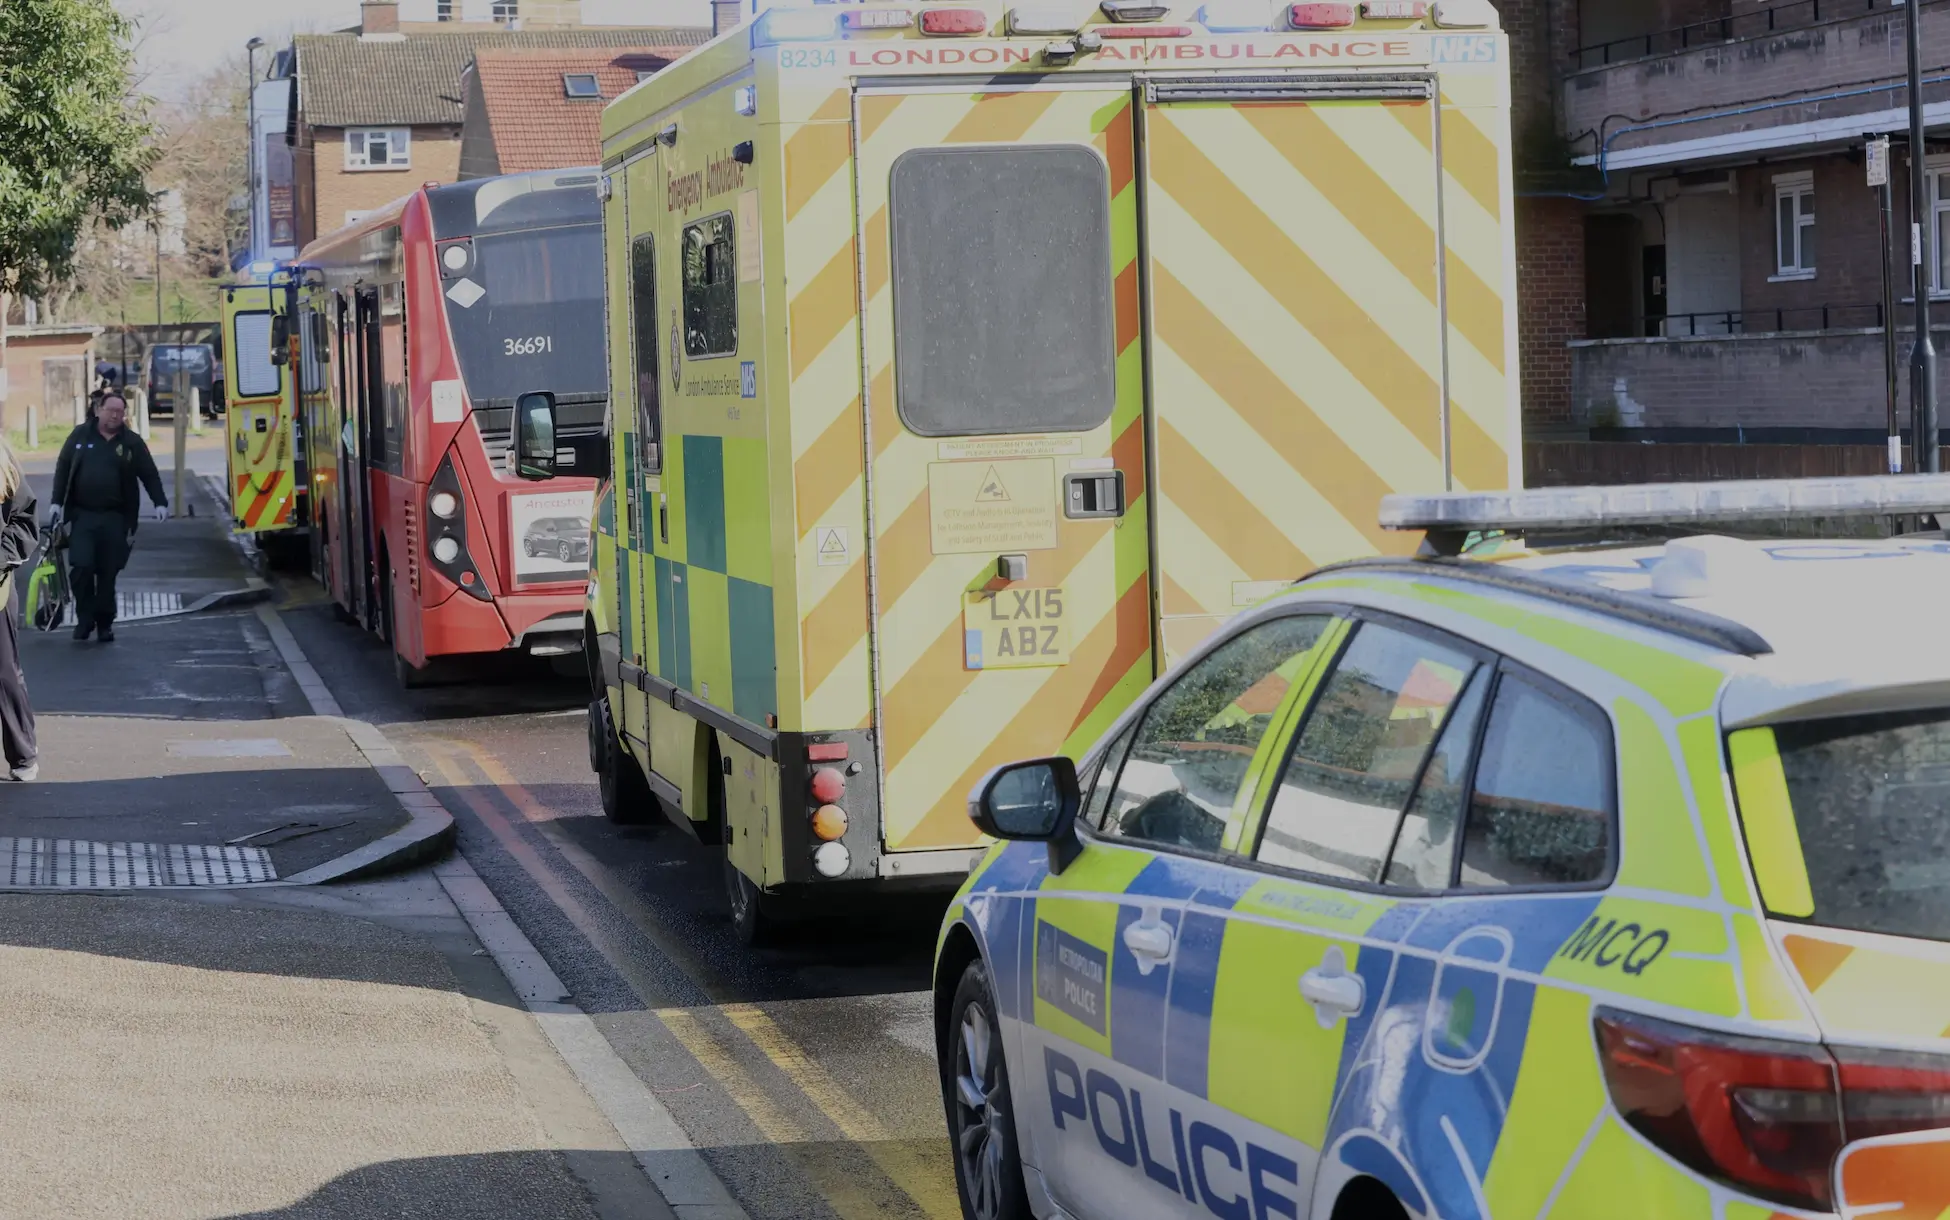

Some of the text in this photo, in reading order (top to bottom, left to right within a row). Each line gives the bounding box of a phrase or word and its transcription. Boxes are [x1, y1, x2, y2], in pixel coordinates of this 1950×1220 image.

[780, 49, 837, 68] 8234
[849, 40, 1412, 66] LONDON AMBULANCE
[1433, 36, 1496, 62] NHS
[667, 147, 744, 216] Emergency Ambulance
[503, 335, 552, 356] 36691
[685, 372, 740, 396] London Ambulance Service
[741, 363, 755, 396] NHS
[524, 498, 584, 509] Ancaster
[943, 509, 961, 518] CCTV
[990, 588, 1063, 621] LX15
[997, 625, 1060, 657] ABZ
[1559, 915, 1670, 977] MCQ
[1058, 944, 1104, 985] METROPOLITAN
[1063, 976, 1097, 1016] POLICE
[1043, 1044, 1298, 1220] POLICE
